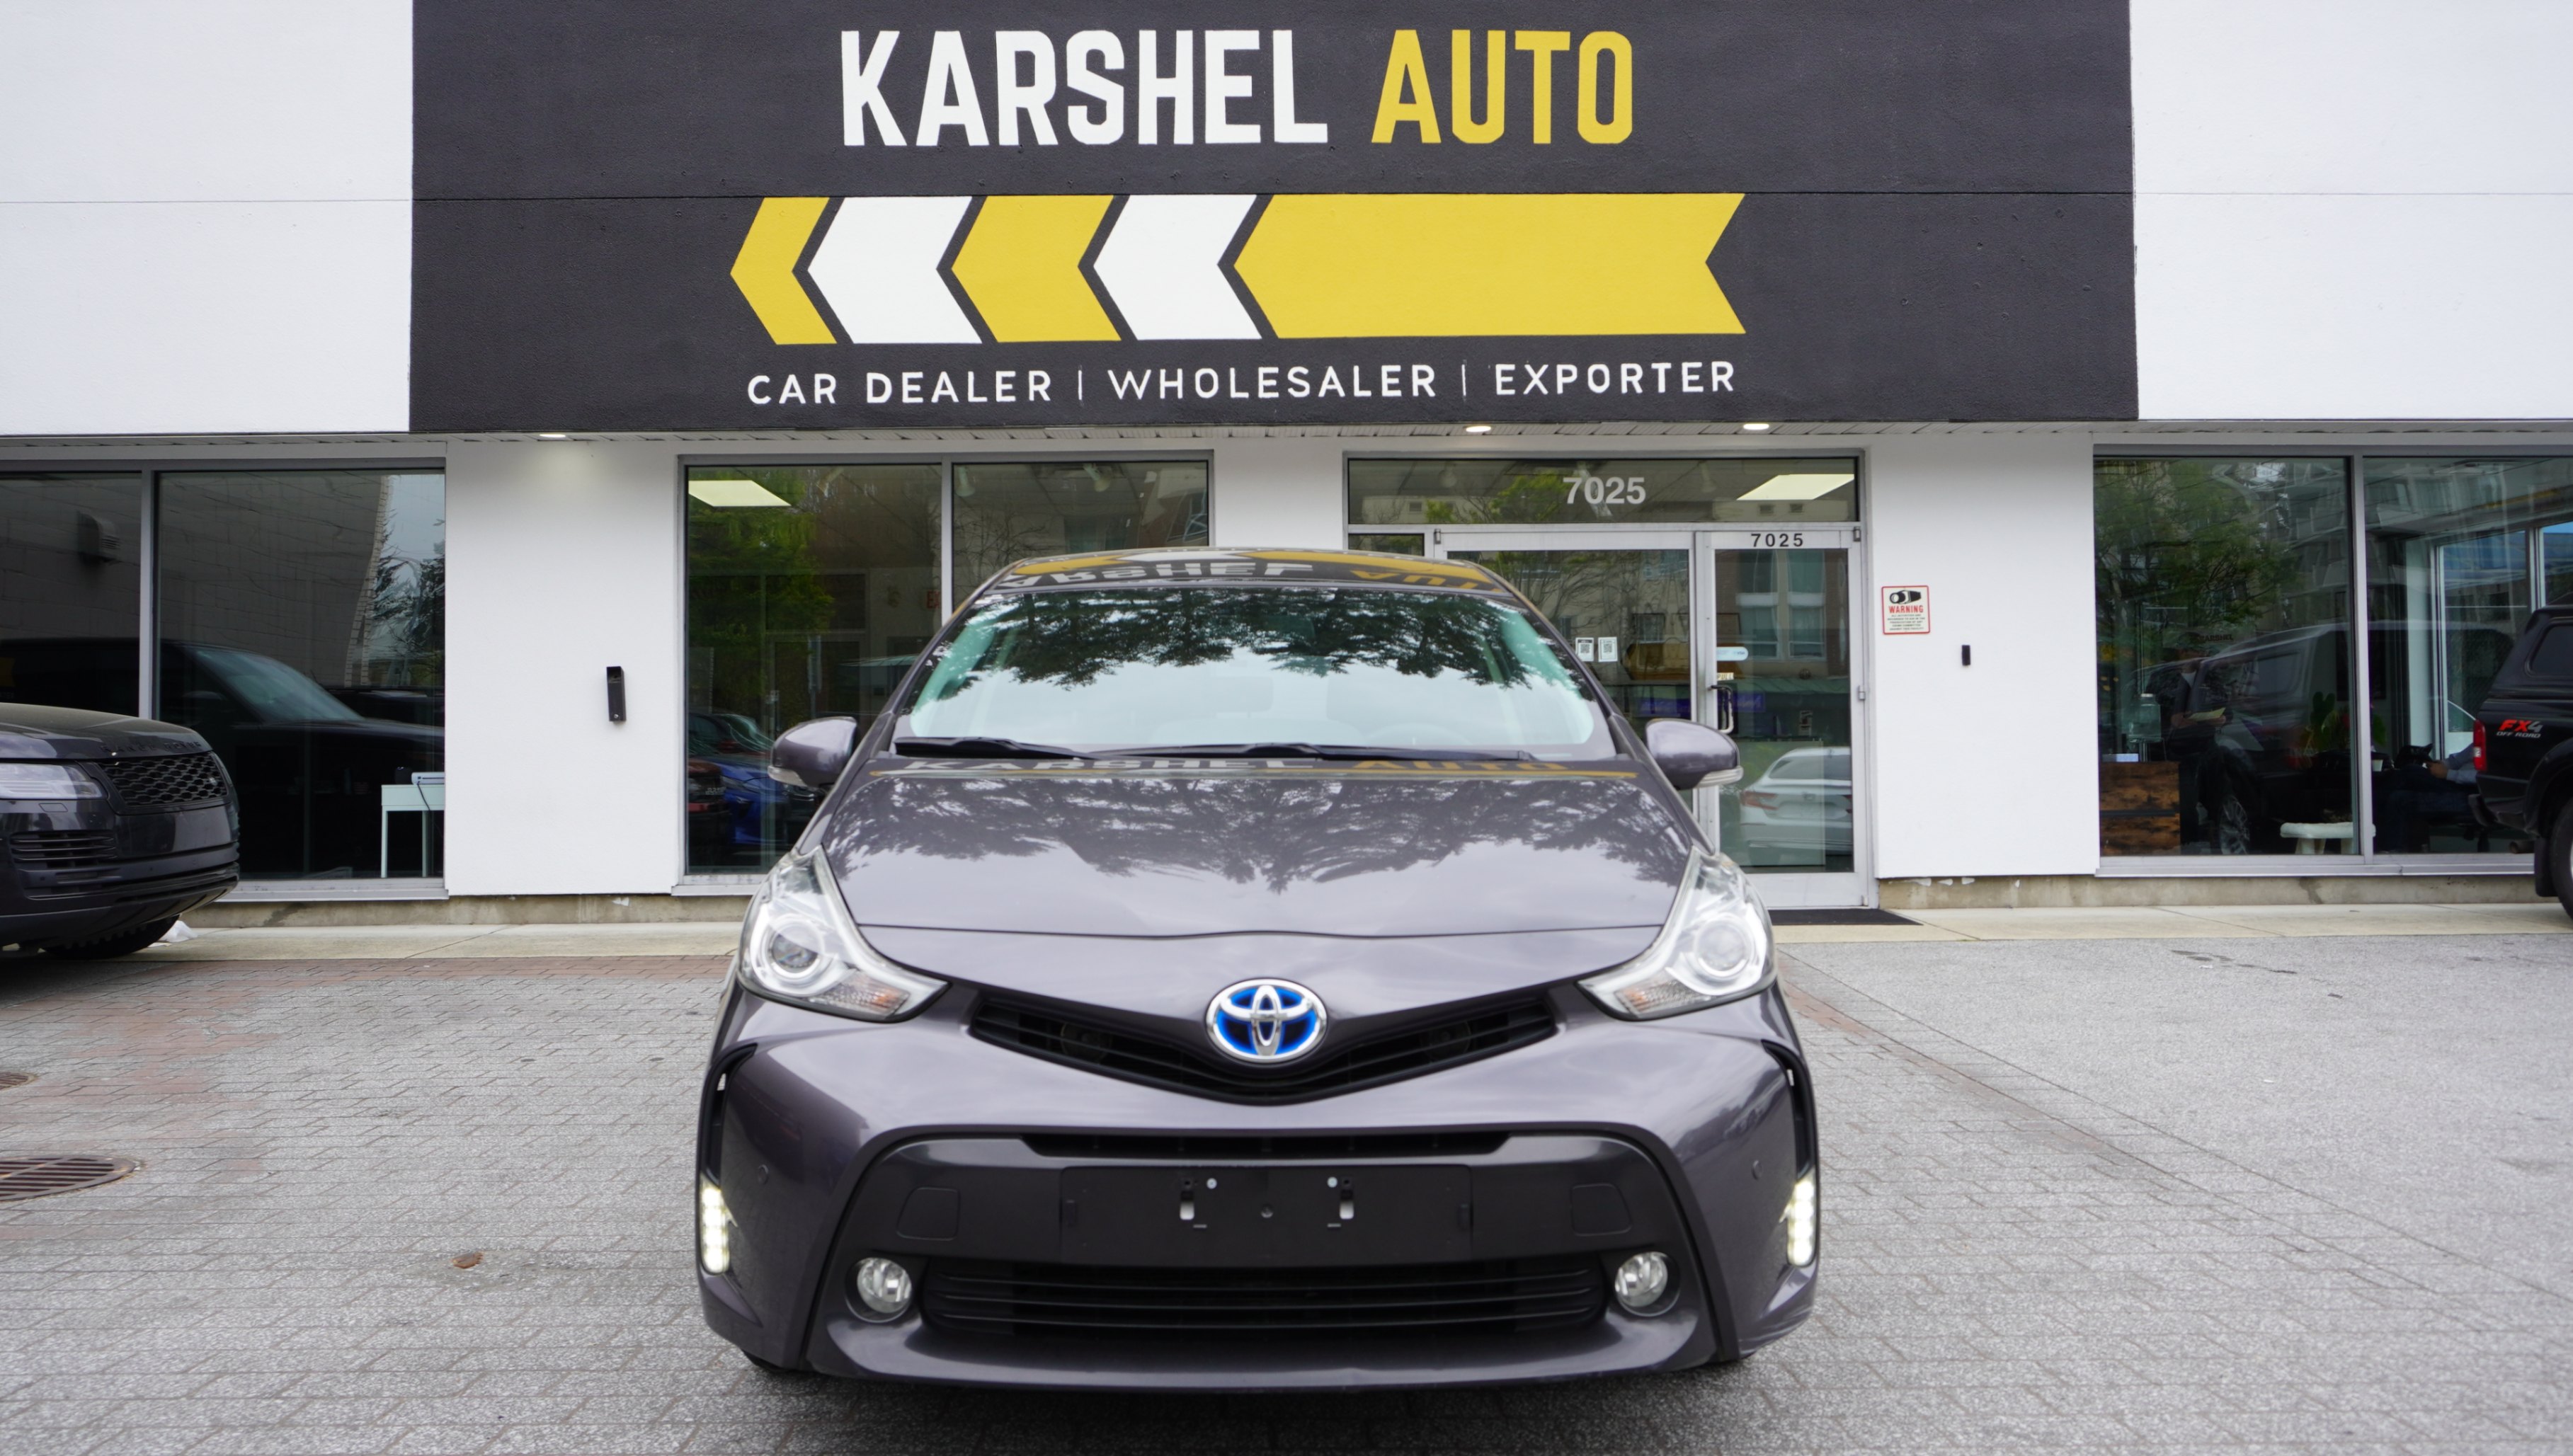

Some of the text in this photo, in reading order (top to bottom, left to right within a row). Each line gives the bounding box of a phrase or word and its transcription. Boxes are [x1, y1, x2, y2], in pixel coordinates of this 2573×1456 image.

[840, 29, 1633, 147] KARSHEL AUTO
[746, 360, 1734, 405] CAR DEALER WHOLESALER EXPORTER
[1562, 476, 1646, 505] 7025
[1750, 533, 1804, 548] 7025
[1888, 605, 1924, 614] WARNING
[2499, 719, 2543, 733] FX4
